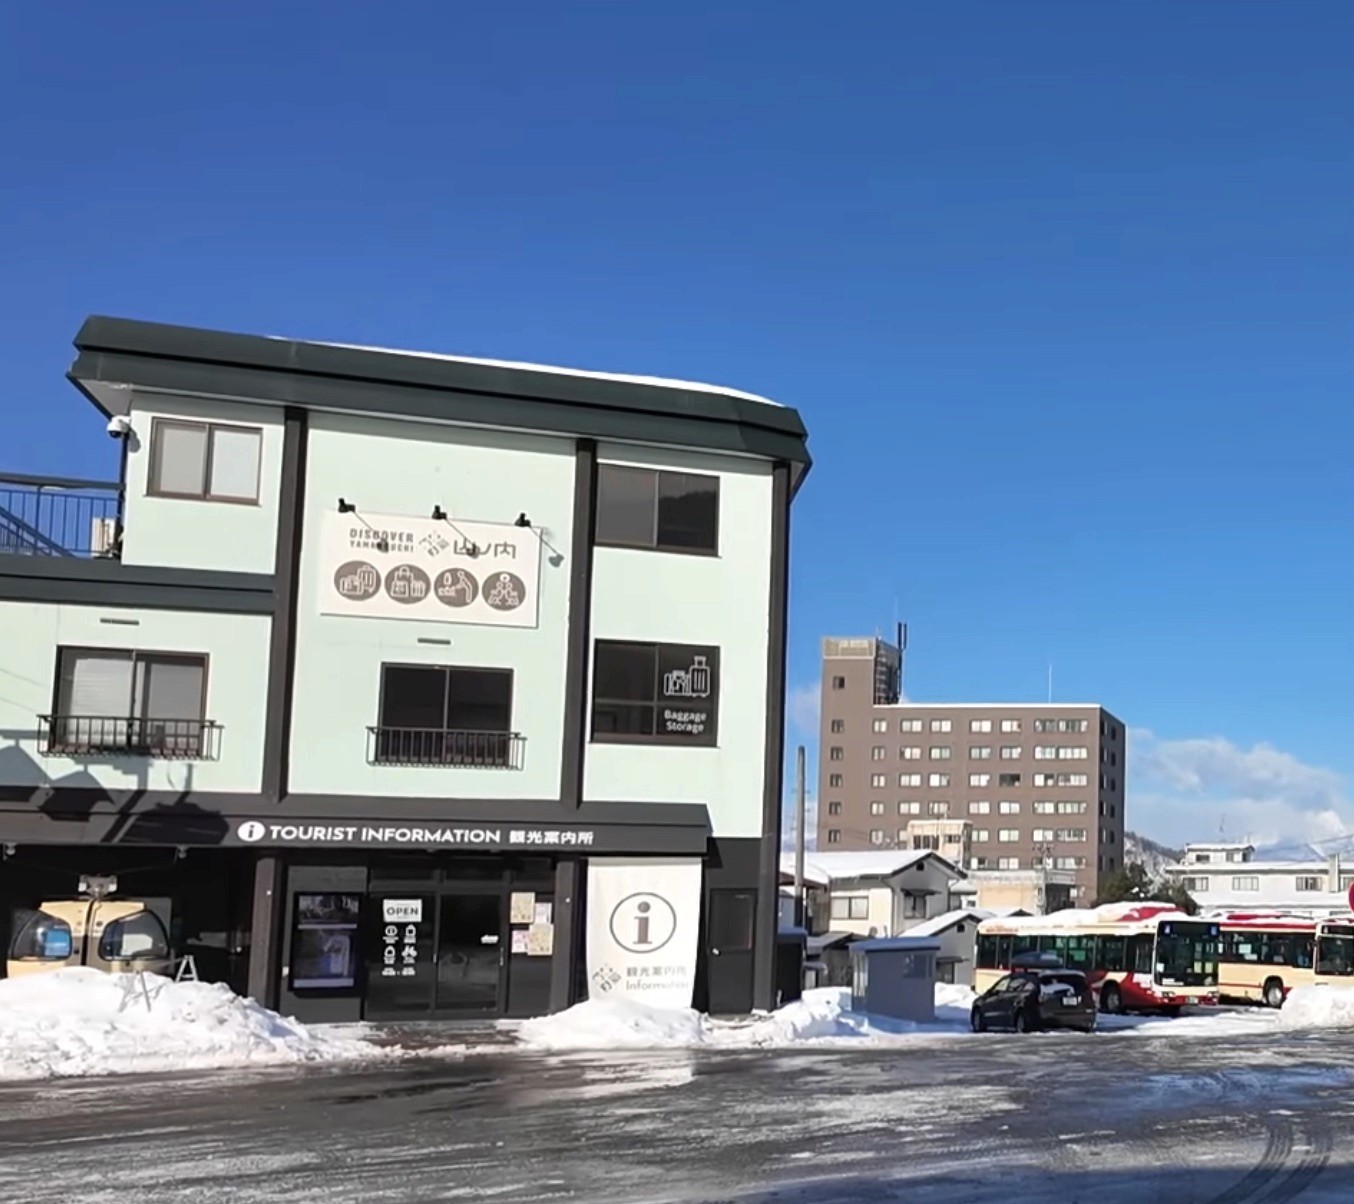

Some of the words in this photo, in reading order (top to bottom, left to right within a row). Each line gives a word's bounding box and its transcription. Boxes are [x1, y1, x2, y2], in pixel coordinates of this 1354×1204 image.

[349, 528, 414, 543] DISCOVER
[349, 540, 414, 553] YAMAUCHI
[664, 709, 707, 722] Baggage
[666, 721, 704, 734] Storage
[270, 825, 357, 841] TOURIST
[361, 827, 501, 843] INFORMATION
[509, 829, 594, 845] 観光案内所
[386, 906, 418, 916] OPEN
